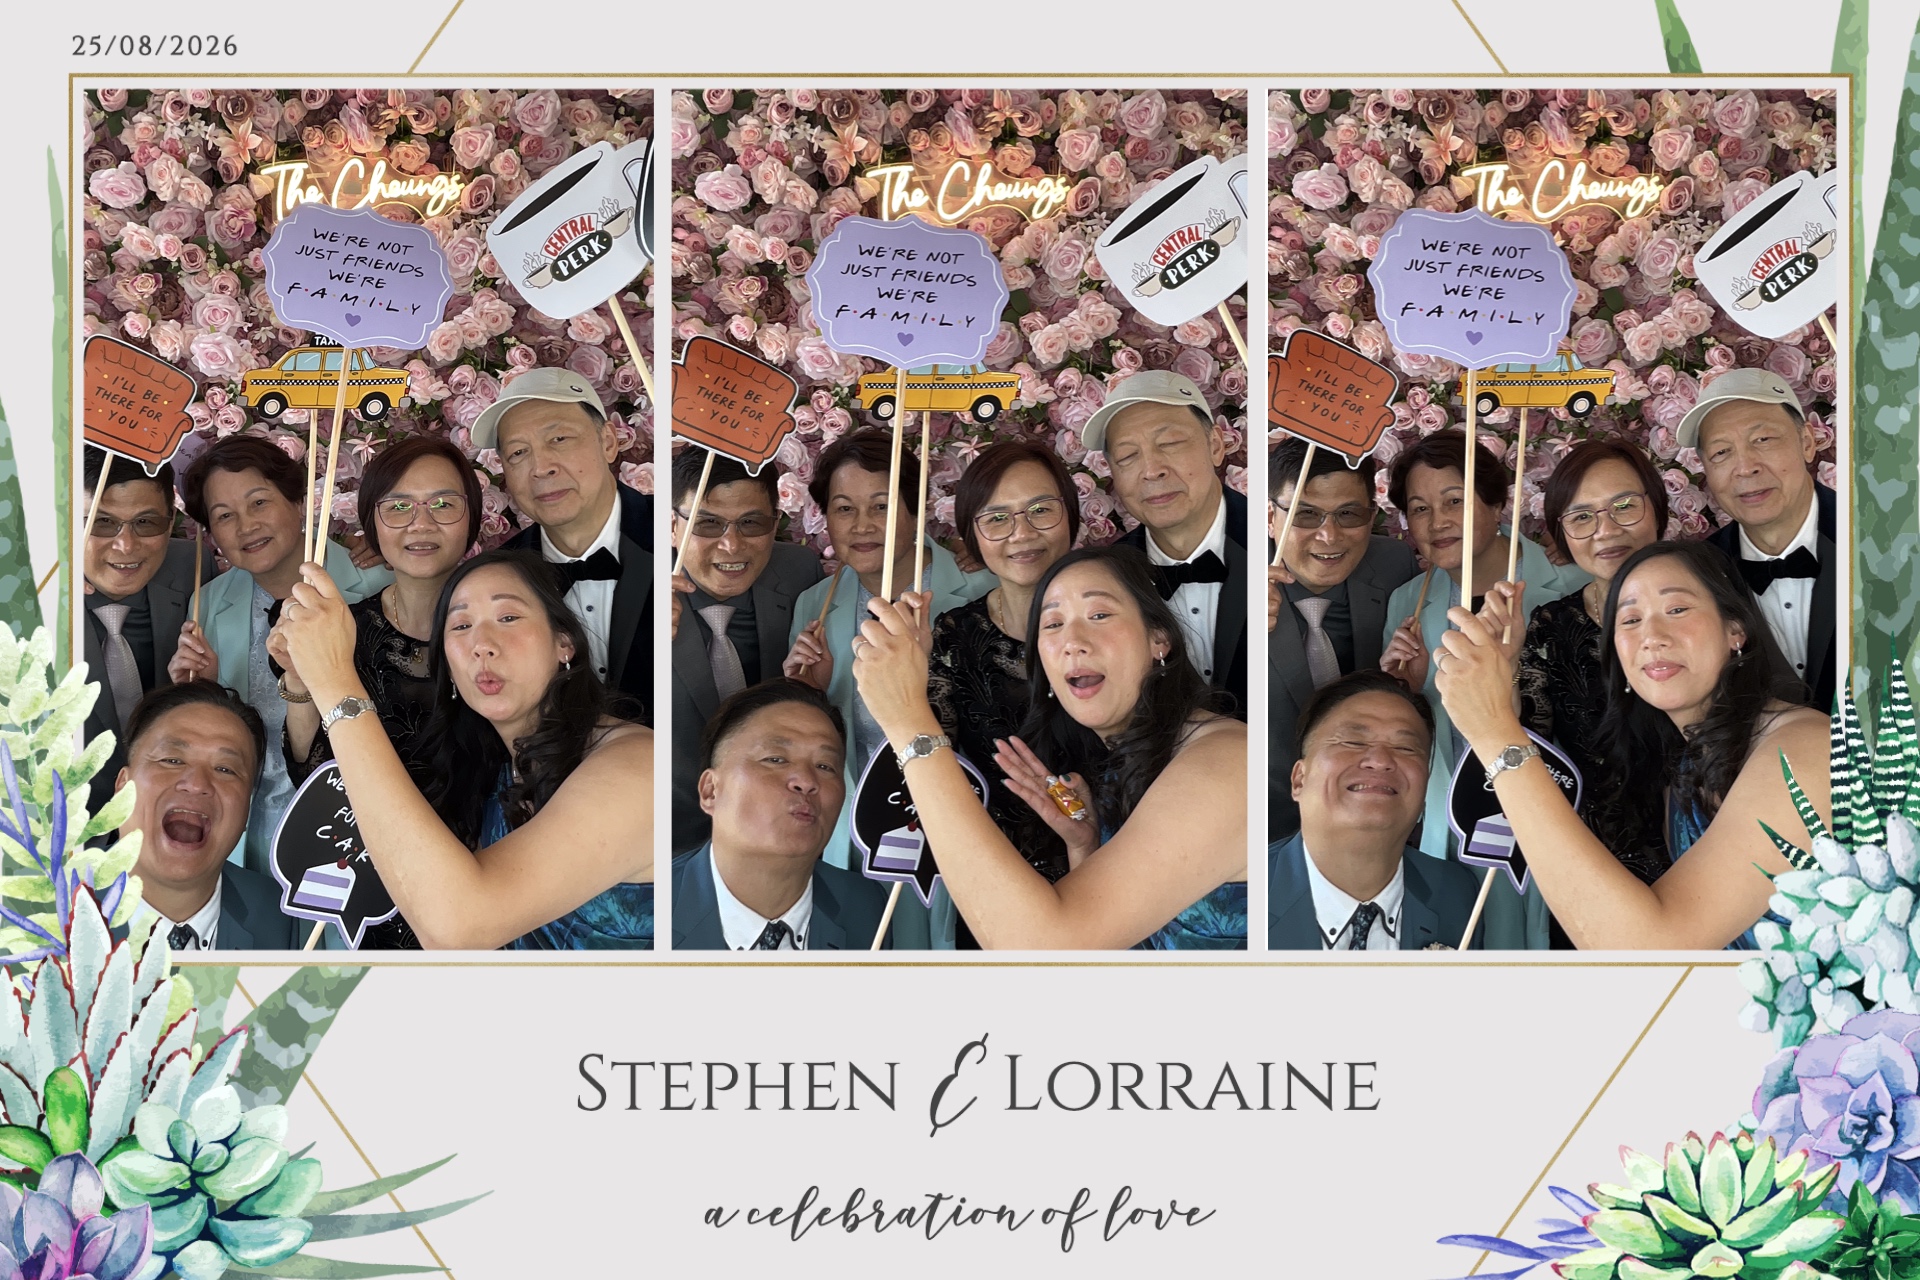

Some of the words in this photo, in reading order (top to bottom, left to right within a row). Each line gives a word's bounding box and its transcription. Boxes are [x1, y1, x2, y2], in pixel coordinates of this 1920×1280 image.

[261, 163, 324, 220] The
[866, 165, 929, 221] The
[1462, 164, 1524, 212] The
[313, 228, 370, 247] WE'RE
[377, 242, 414, 255] NOT
[544, 215, 595, 257] CENTRAL
[1152, 225, 1202, 267] CENTRAL
[1421, 238, 1484, 256] WE'RE
[1492, 246, 1531, 260] NOT
[295, 245, 339, 260] JUST
[342, 254, 424, 277] FRIENDS
[557, 235, 607, 276] PERK
[858, 244, 918, 261] WE'RE
[926, 251, 965, 265] NOT
[1166, 244, 1214, 284] PERK
[1751, 239, 1800, 280] CENTRAL
[329, 269, 387, 288] WE'RE
[840, 263, 887, 278] JUST
[891, 268, 977, 287] FRIENDS
[1404, 258, 1452, 273] JUST
[1457, 264, 1545, 282] FRIENDS
[1765, 257, 1813, 298] PERK
[877, 287, 938, 303] WE'RE
[1443, 283, 1506, 300] WE'RE
[112, 375, 136, 394] I'LL
[142, 389, 161, 403] BE
[713, 375, 737, 394] I'LL
[744, 389, 763, 403] BE
[1314, 369, 1338, 386] I'LL
[1344, 383, 1363, 397] BE
[95, 386, 135, 410] THERE
[139, 406, 163, 422] FOR
[696, 386, 737, 410] THERE
[740, 406, 765, 422] FOR
[1298, 379, 1338, 402] THERE
[1341, 399, 1365, 416] FOR
[107, 410, 139, 429] YOU
[710, 409, 740, 429] YOU
[1310, 402, 1341, 422] YOU
